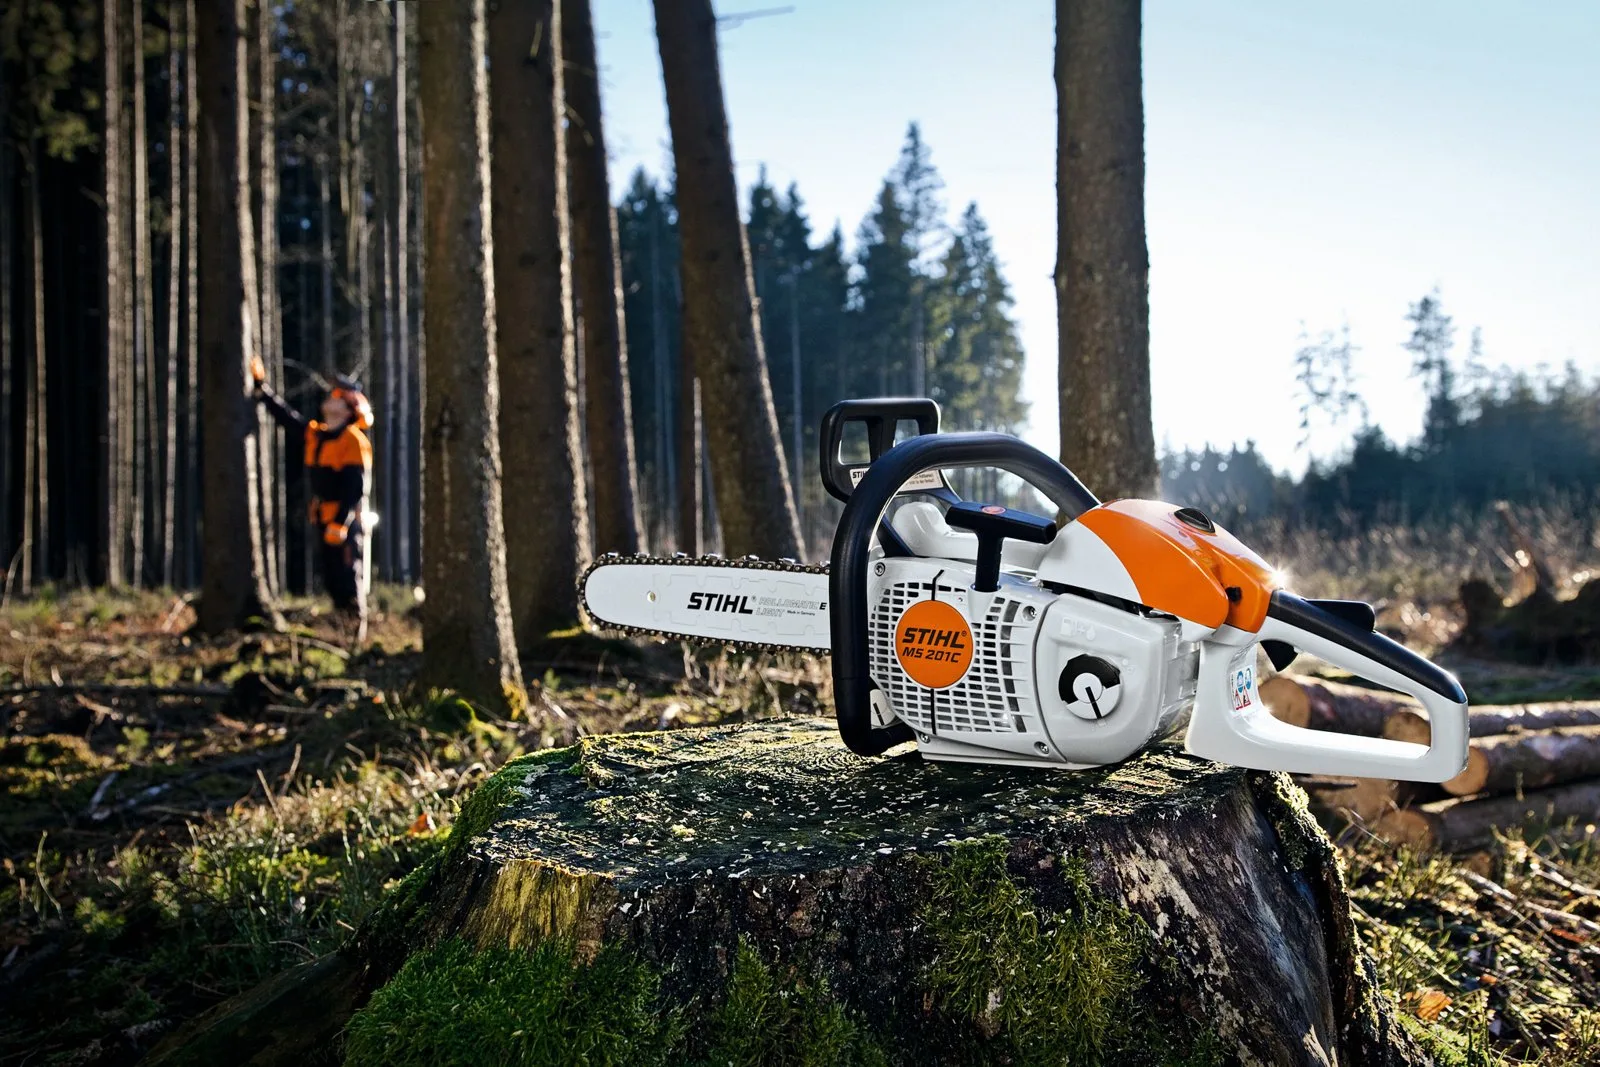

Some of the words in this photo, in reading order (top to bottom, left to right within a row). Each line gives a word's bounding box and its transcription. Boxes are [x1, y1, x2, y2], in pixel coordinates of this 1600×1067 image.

[687, 592, 753, 614] STIHL
[902, 627, 965, 649] STIHL
[902, 646, 924, 659] MS
[925, 649, 962, 663] 201C
